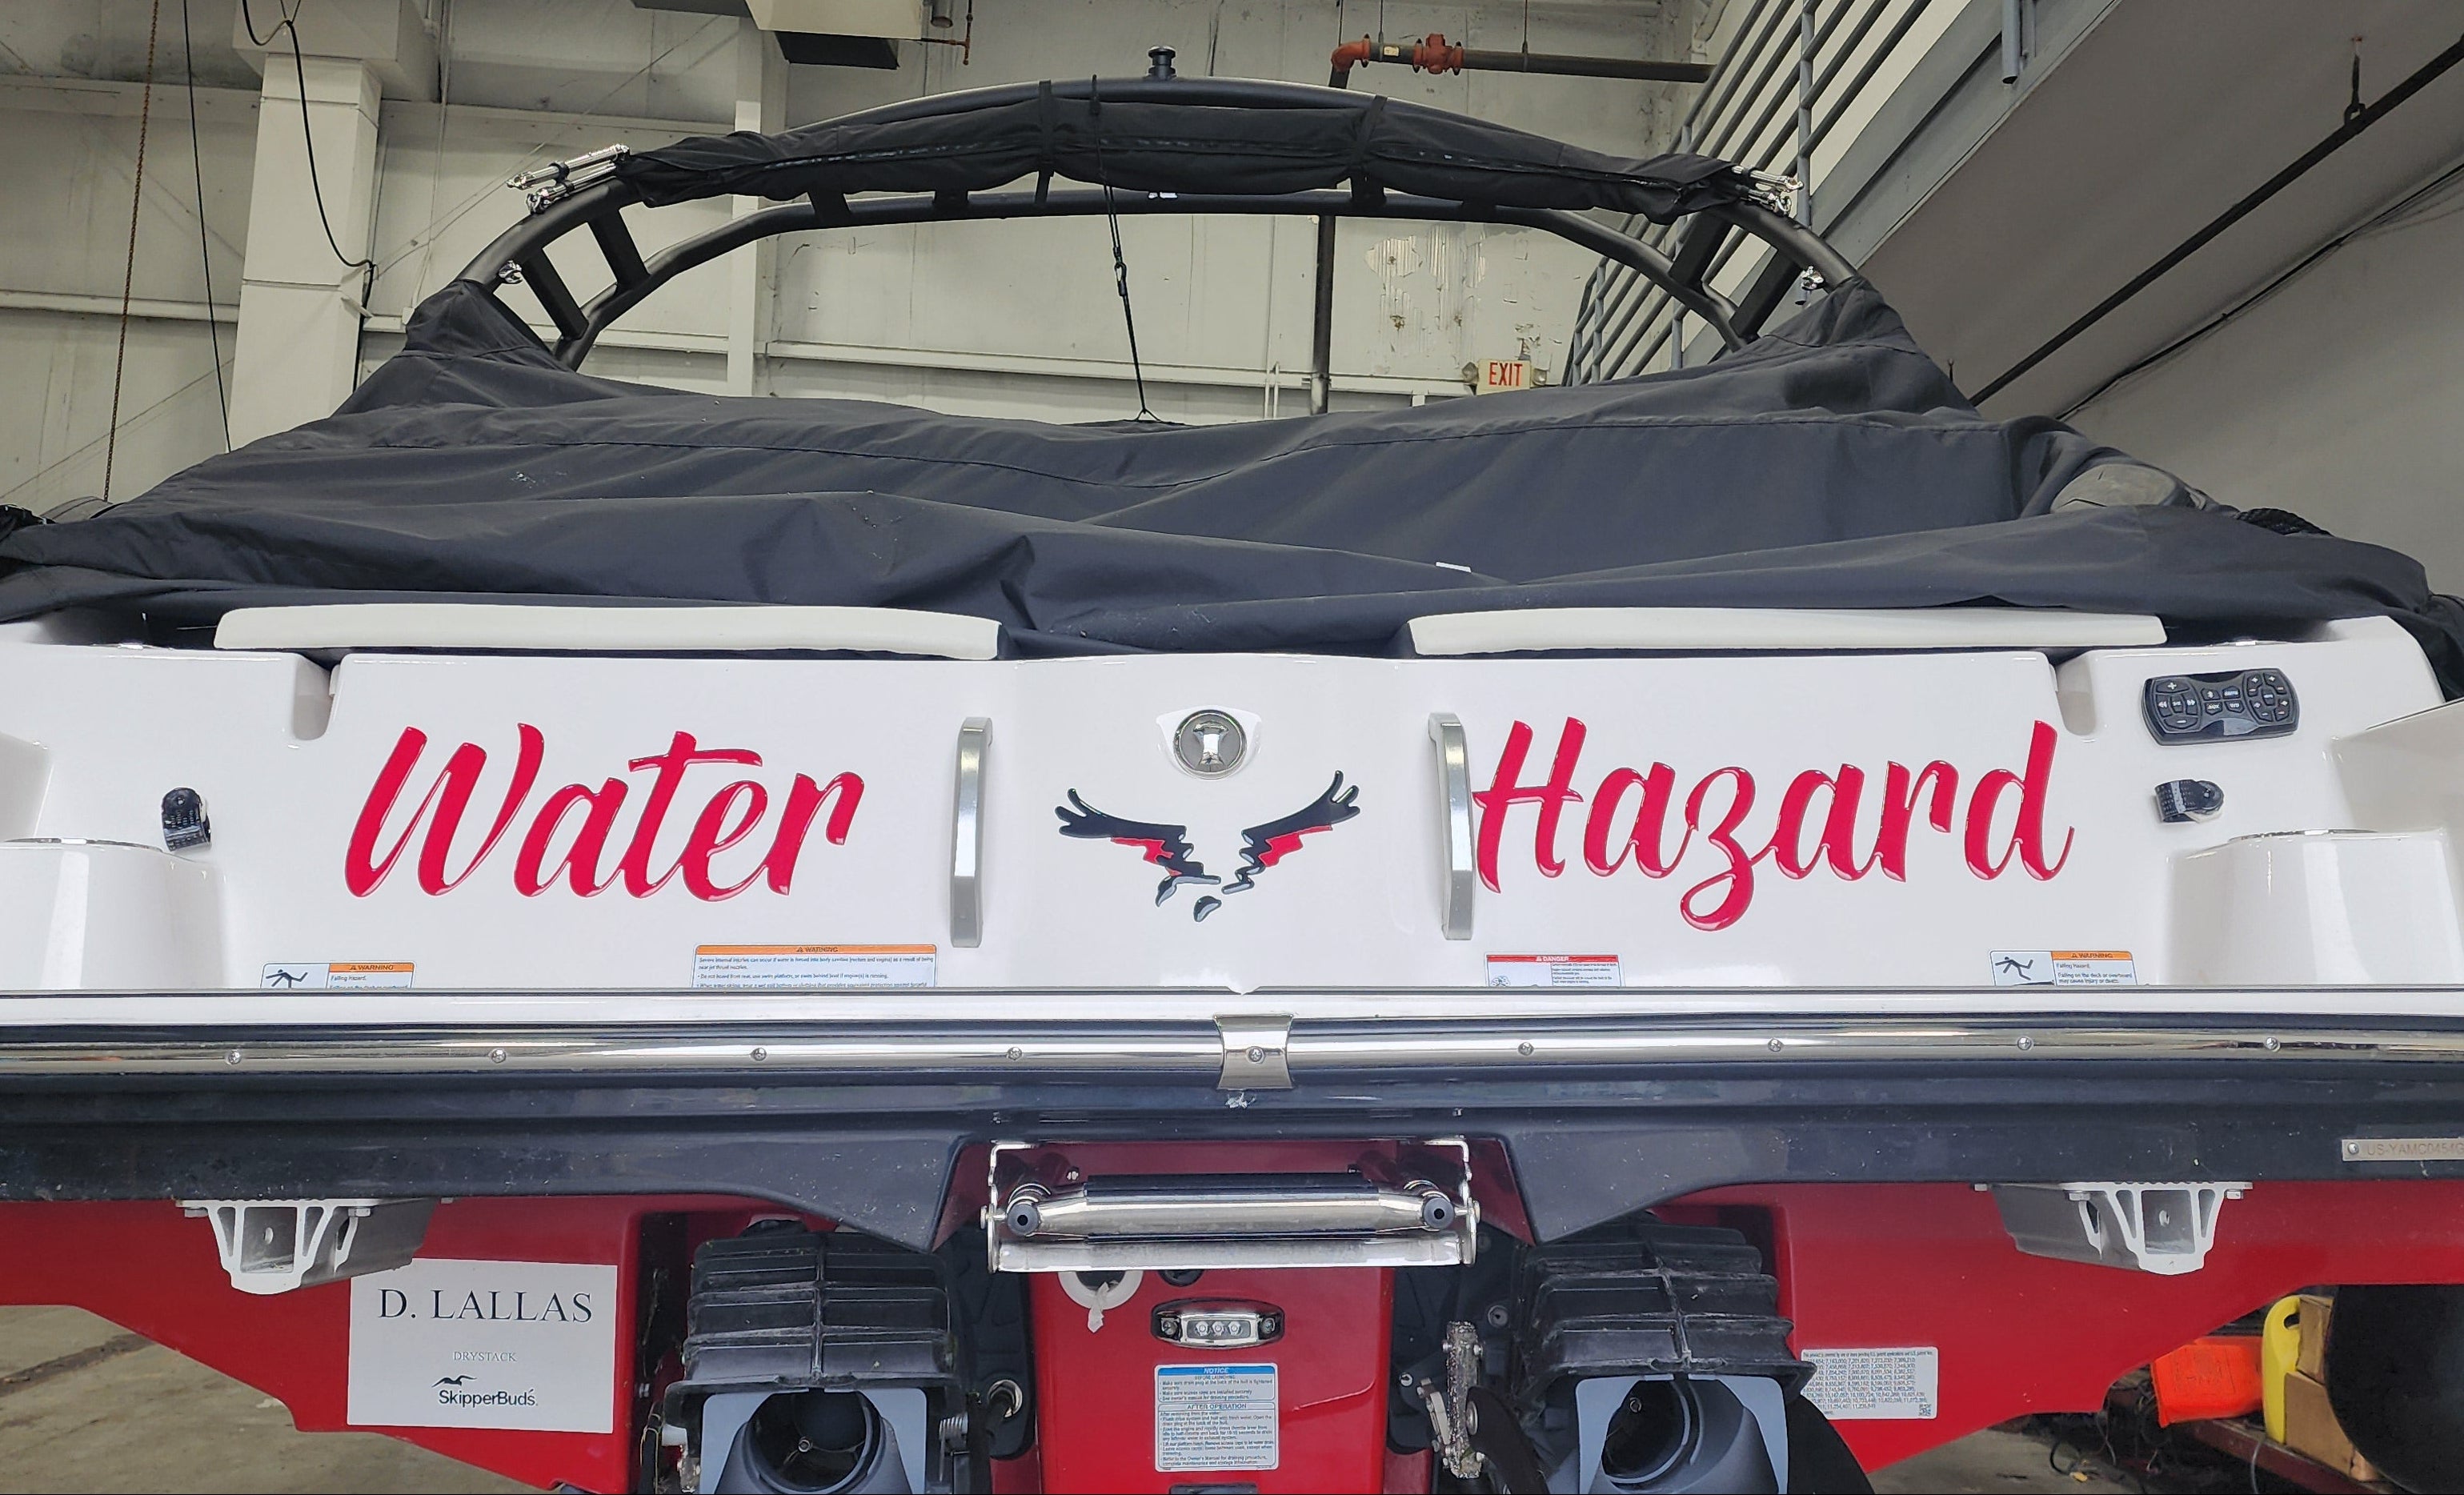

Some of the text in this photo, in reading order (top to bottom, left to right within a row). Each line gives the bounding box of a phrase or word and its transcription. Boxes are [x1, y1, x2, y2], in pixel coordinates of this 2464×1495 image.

[1488, 362, 1523, 387] EXIT
[345, 716, 2075, 932] Water Hazard
[378, 1289, 592, 1323] D. LALLAS
[453, 1351, 517, 1361] DRYSTACK
